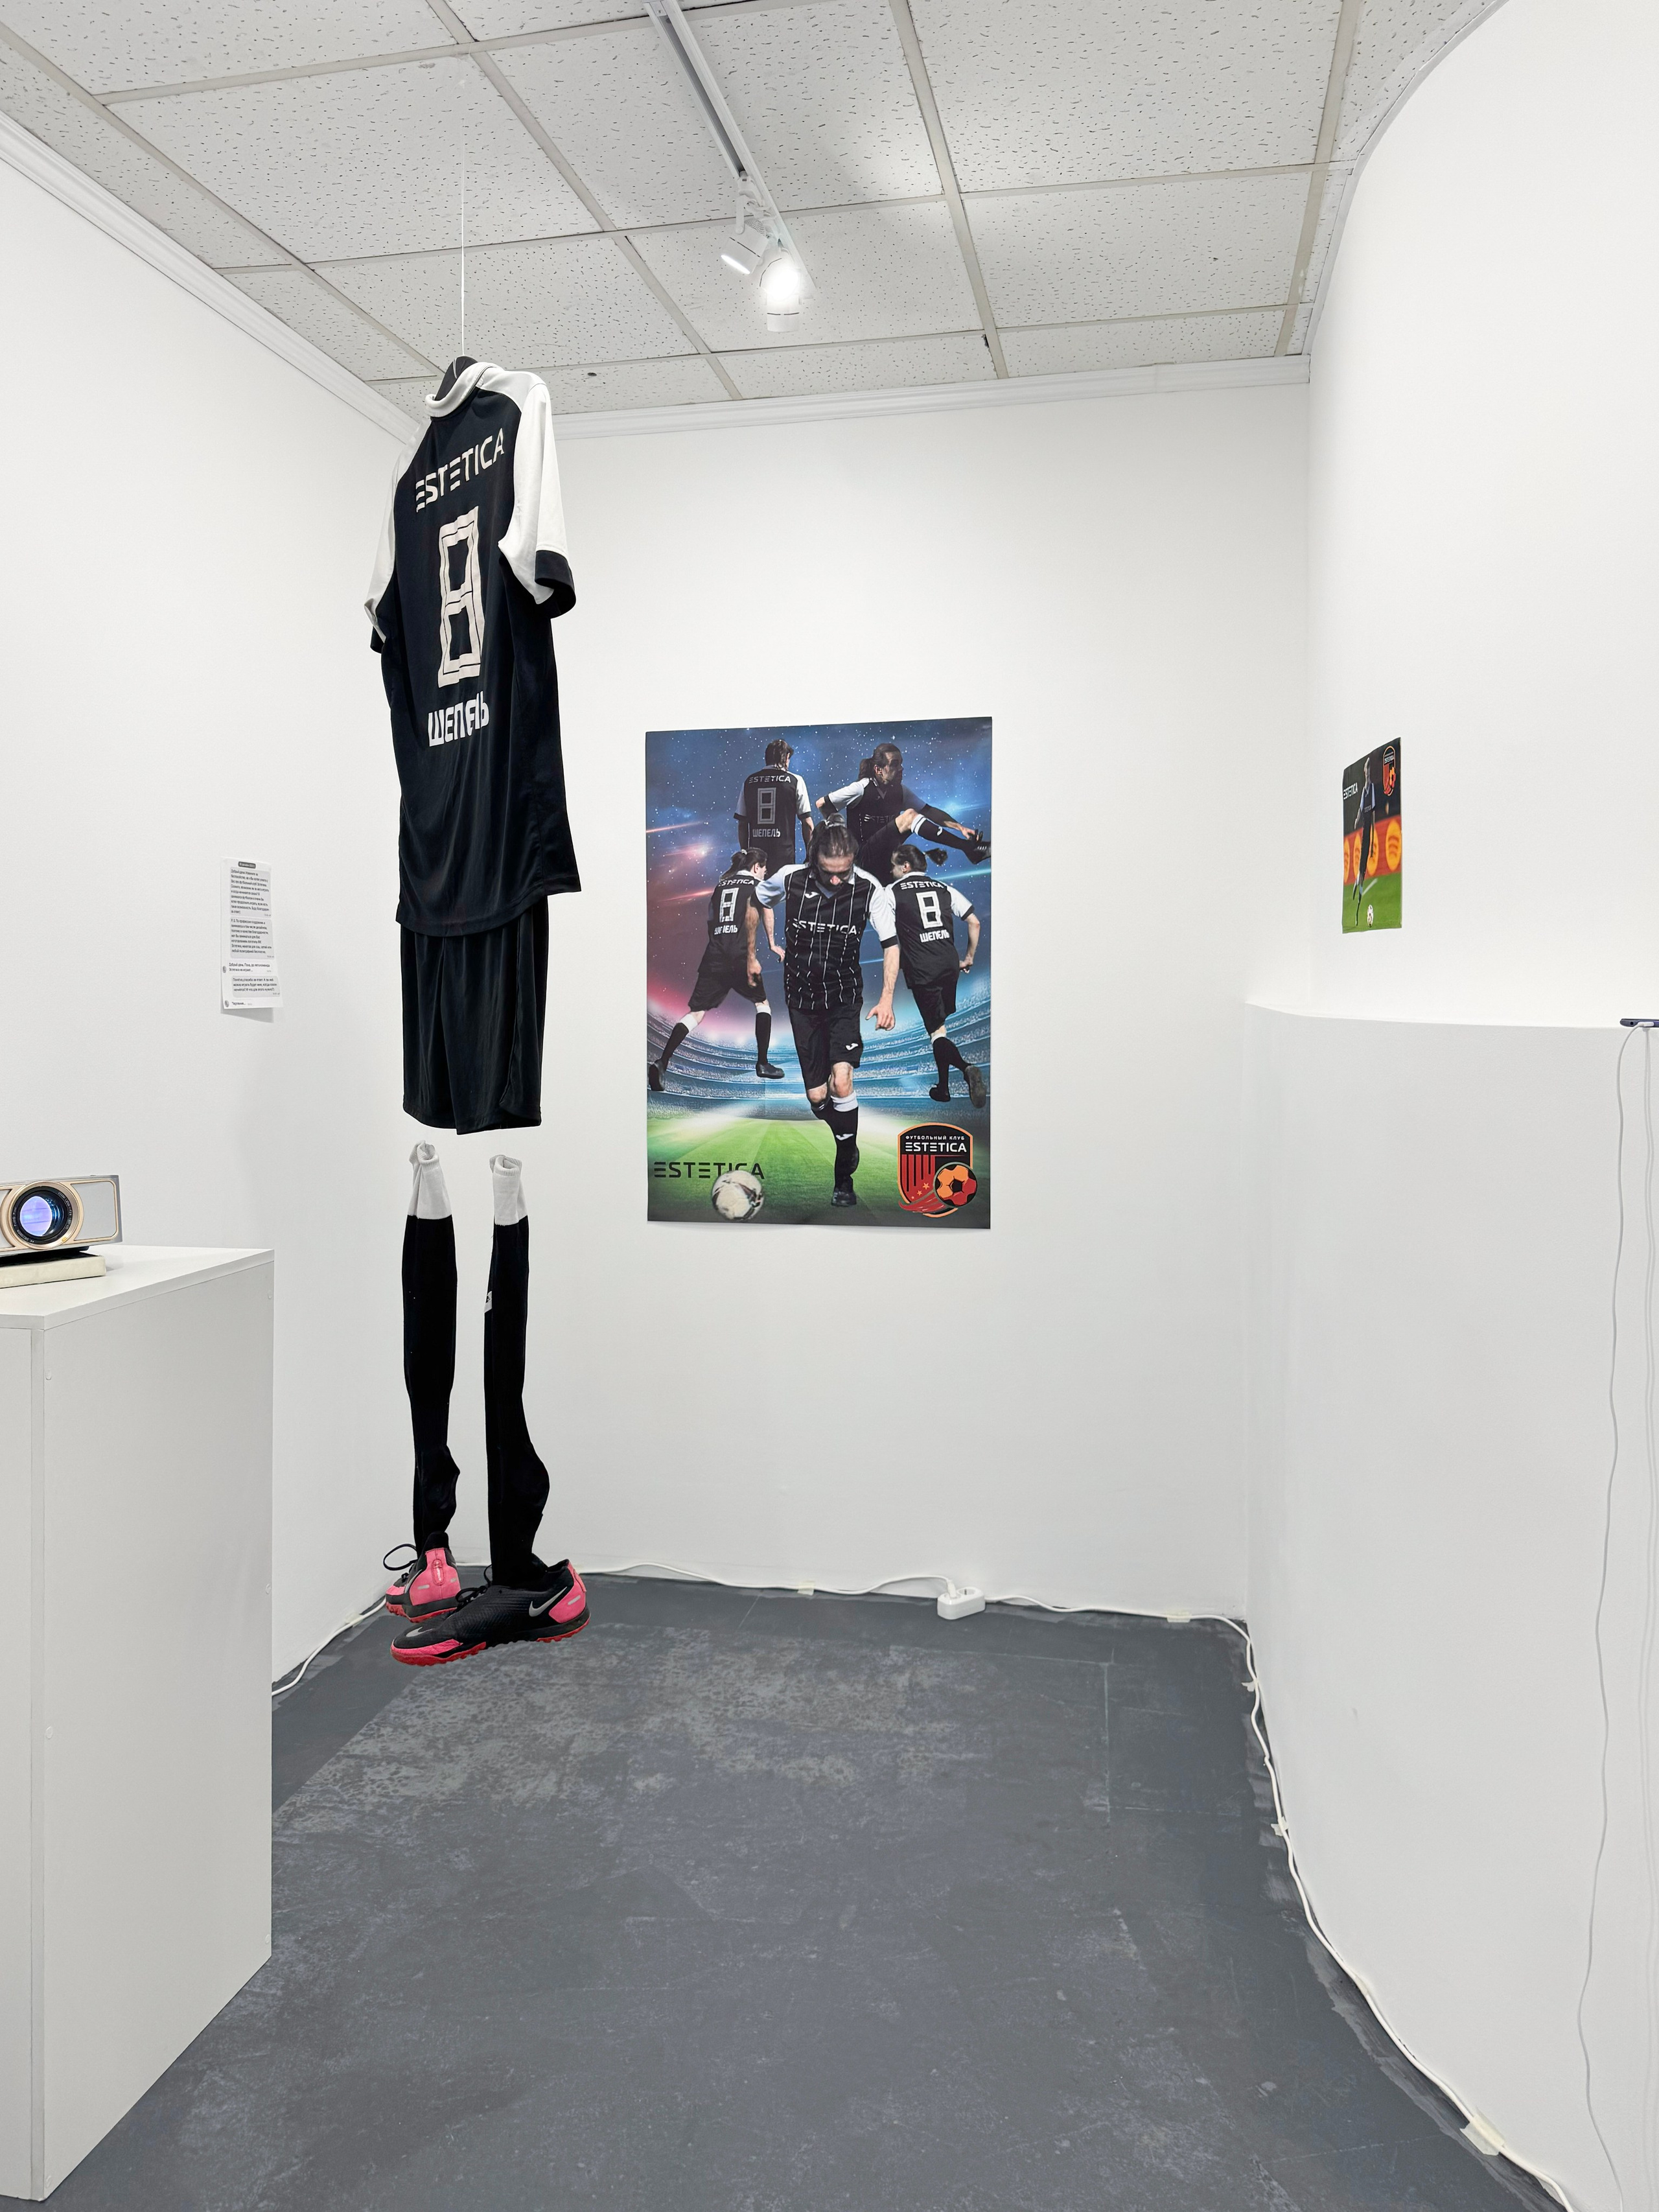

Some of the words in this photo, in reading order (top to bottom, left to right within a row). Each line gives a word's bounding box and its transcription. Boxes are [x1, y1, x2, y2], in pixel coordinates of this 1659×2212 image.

[416, 428, 504, 512] ESTETICA
[437, 506, 485, 688] 8
[748, 774, 791, 784] ESTETICA
[1343, 782, 1358, 800] ESTETICA
[757, 787, 776, 824] 8
[752, 828, 781, 838] ШЕПЕЛЬ
[900, 881, 944, 891] ESTETICA
[719, 887, 739, 923] 8
[916, 891, 944, 929] 8
[792, 918, 857, 935] ESTETICA
[905, 1142, 967, 1152] ESTETICA
